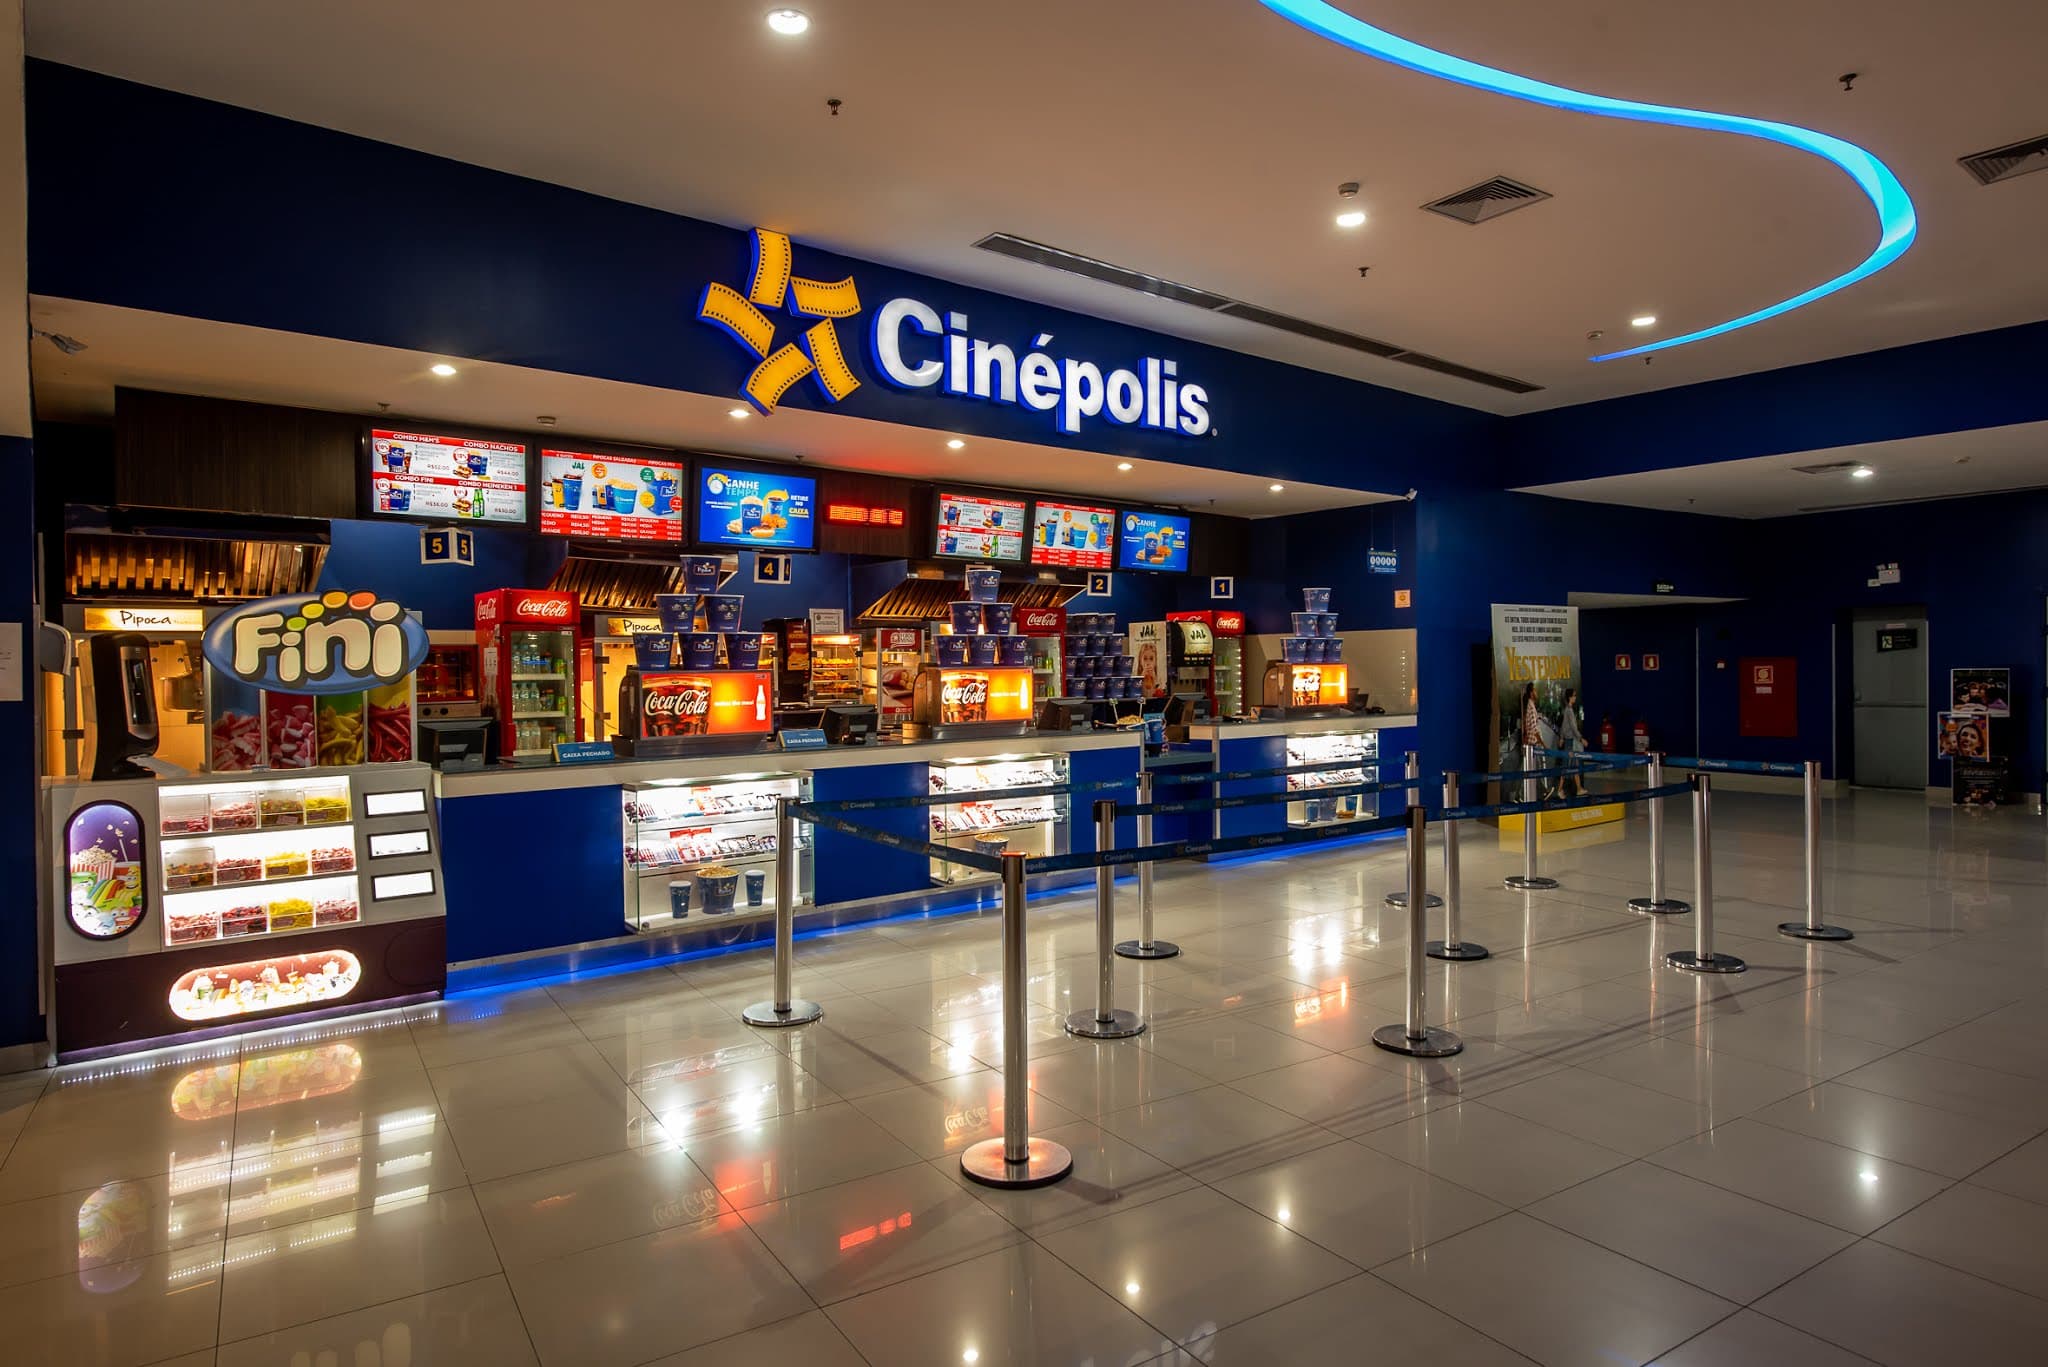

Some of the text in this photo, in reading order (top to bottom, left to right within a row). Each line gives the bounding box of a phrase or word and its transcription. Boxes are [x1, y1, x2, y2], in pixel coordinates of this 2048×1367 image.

[871, 297, 1211, 436] Cinépolis
[393, 433, 418, 441] COMBO
[464, 441, 518, 452] COMBO NACHOS
[726, 479, 760, 490] GANHE
[726, 488, 759, 496] TEMPO
[432, 537, 443, 554] 5
[461, 538, 468, 556] 5
[763, 561, 774, 576] 4
[1095, 578, 1104, 591] 2
[1219, 582, 1225, 592] 1
[477, 597, 497, 622] Coca-Cola
[516, 598, 570, 618] Coca-Cola
[120, 610, 172, 627] Pipoca
[622, 618, 661, 632] Pipoca
[1026, 612, 1059, 626] Coca-Cola
[232, 601, 405, 684] Fini
[1504, 646, 1571, 681] YESTERDAY
[941, 682, 988, 705] Coca-Cola
[645, 689, 711, 716] Coca-Cola
[562, 750, 611, 759] CAIXA FECHADO
